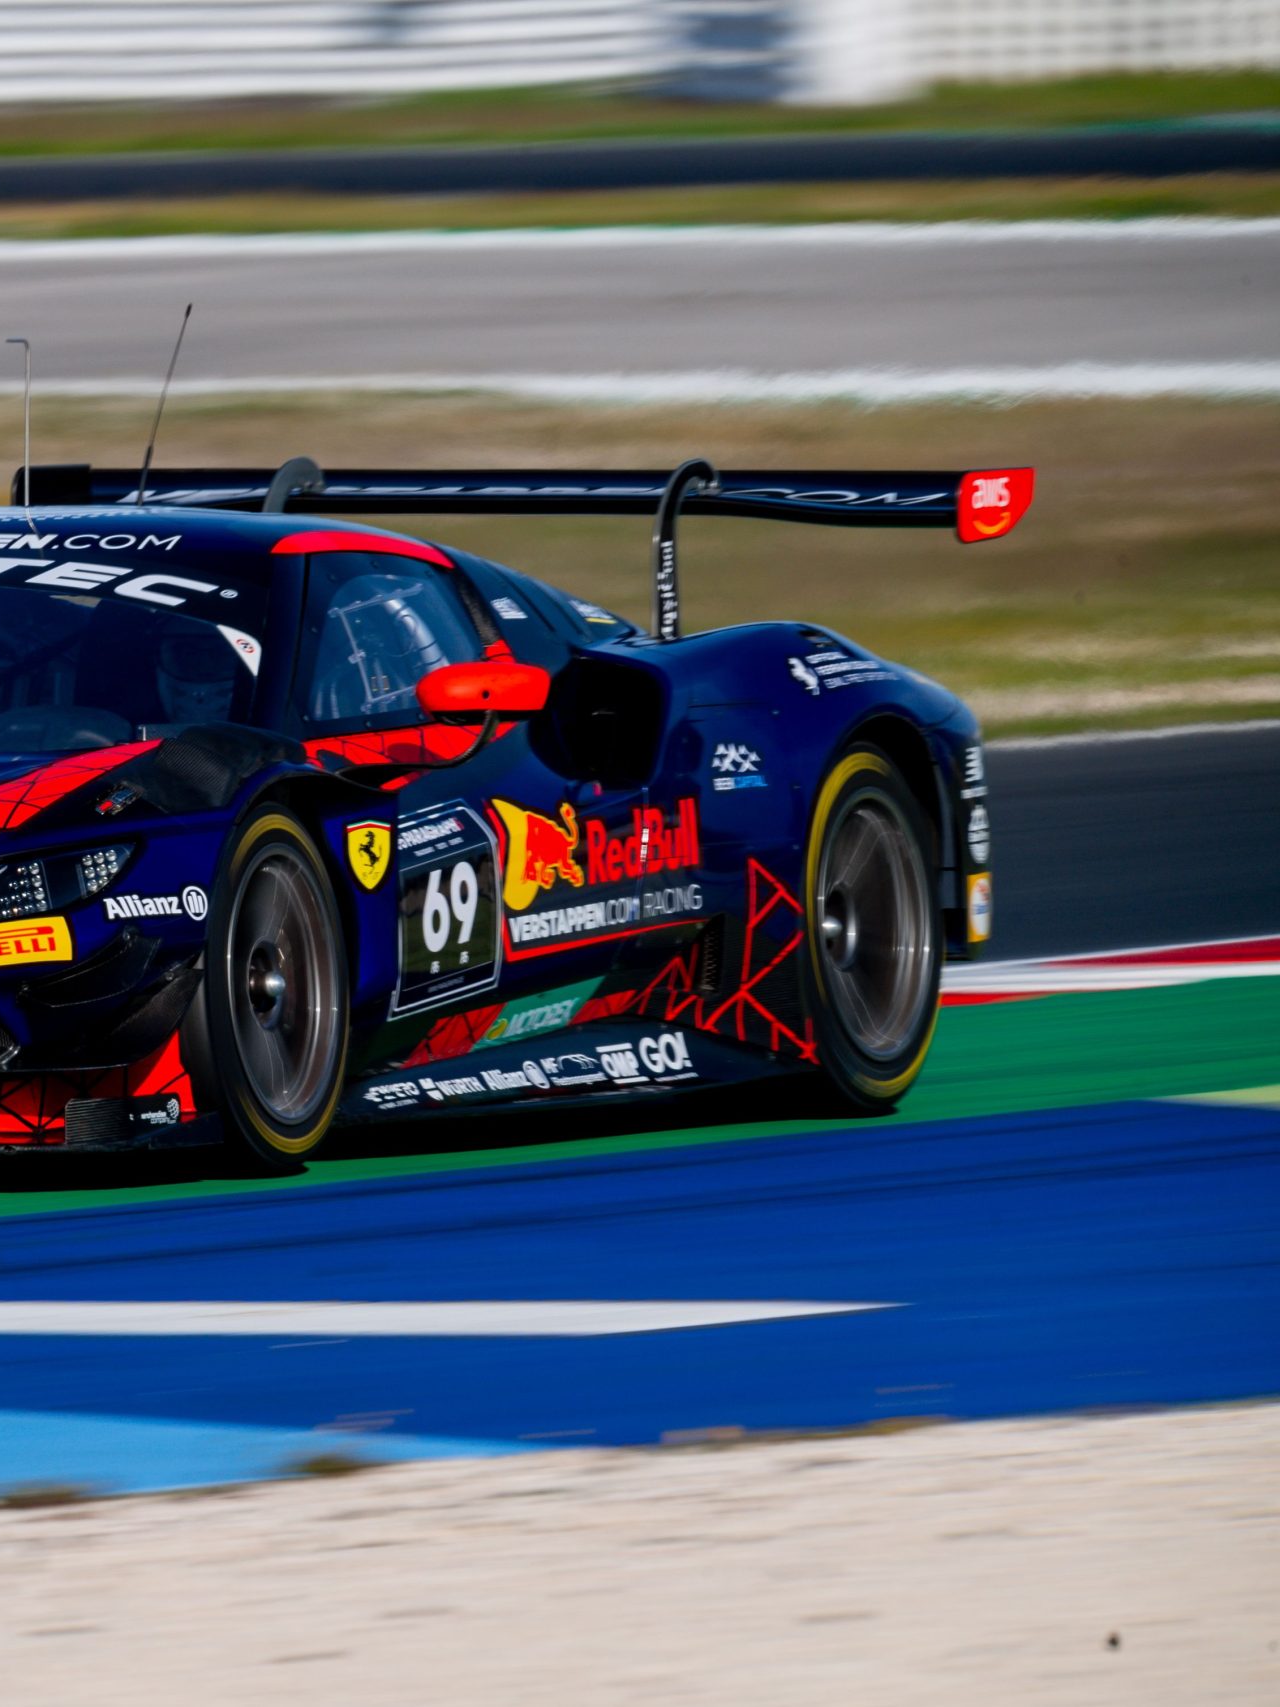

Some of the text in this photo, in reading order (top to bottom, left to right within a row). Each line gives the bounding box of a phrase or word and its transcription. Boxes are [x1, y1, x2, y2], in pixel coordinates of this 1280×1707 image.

[586, 798, 700, 885] Red Bull
[103, 894, 183, 919] Allianz
[422, 862, 479, 953] 69
[509, 884, 703, 943] VERSTAPPEN.COM RACING
[639, 1031, 694, 1074] GO!
